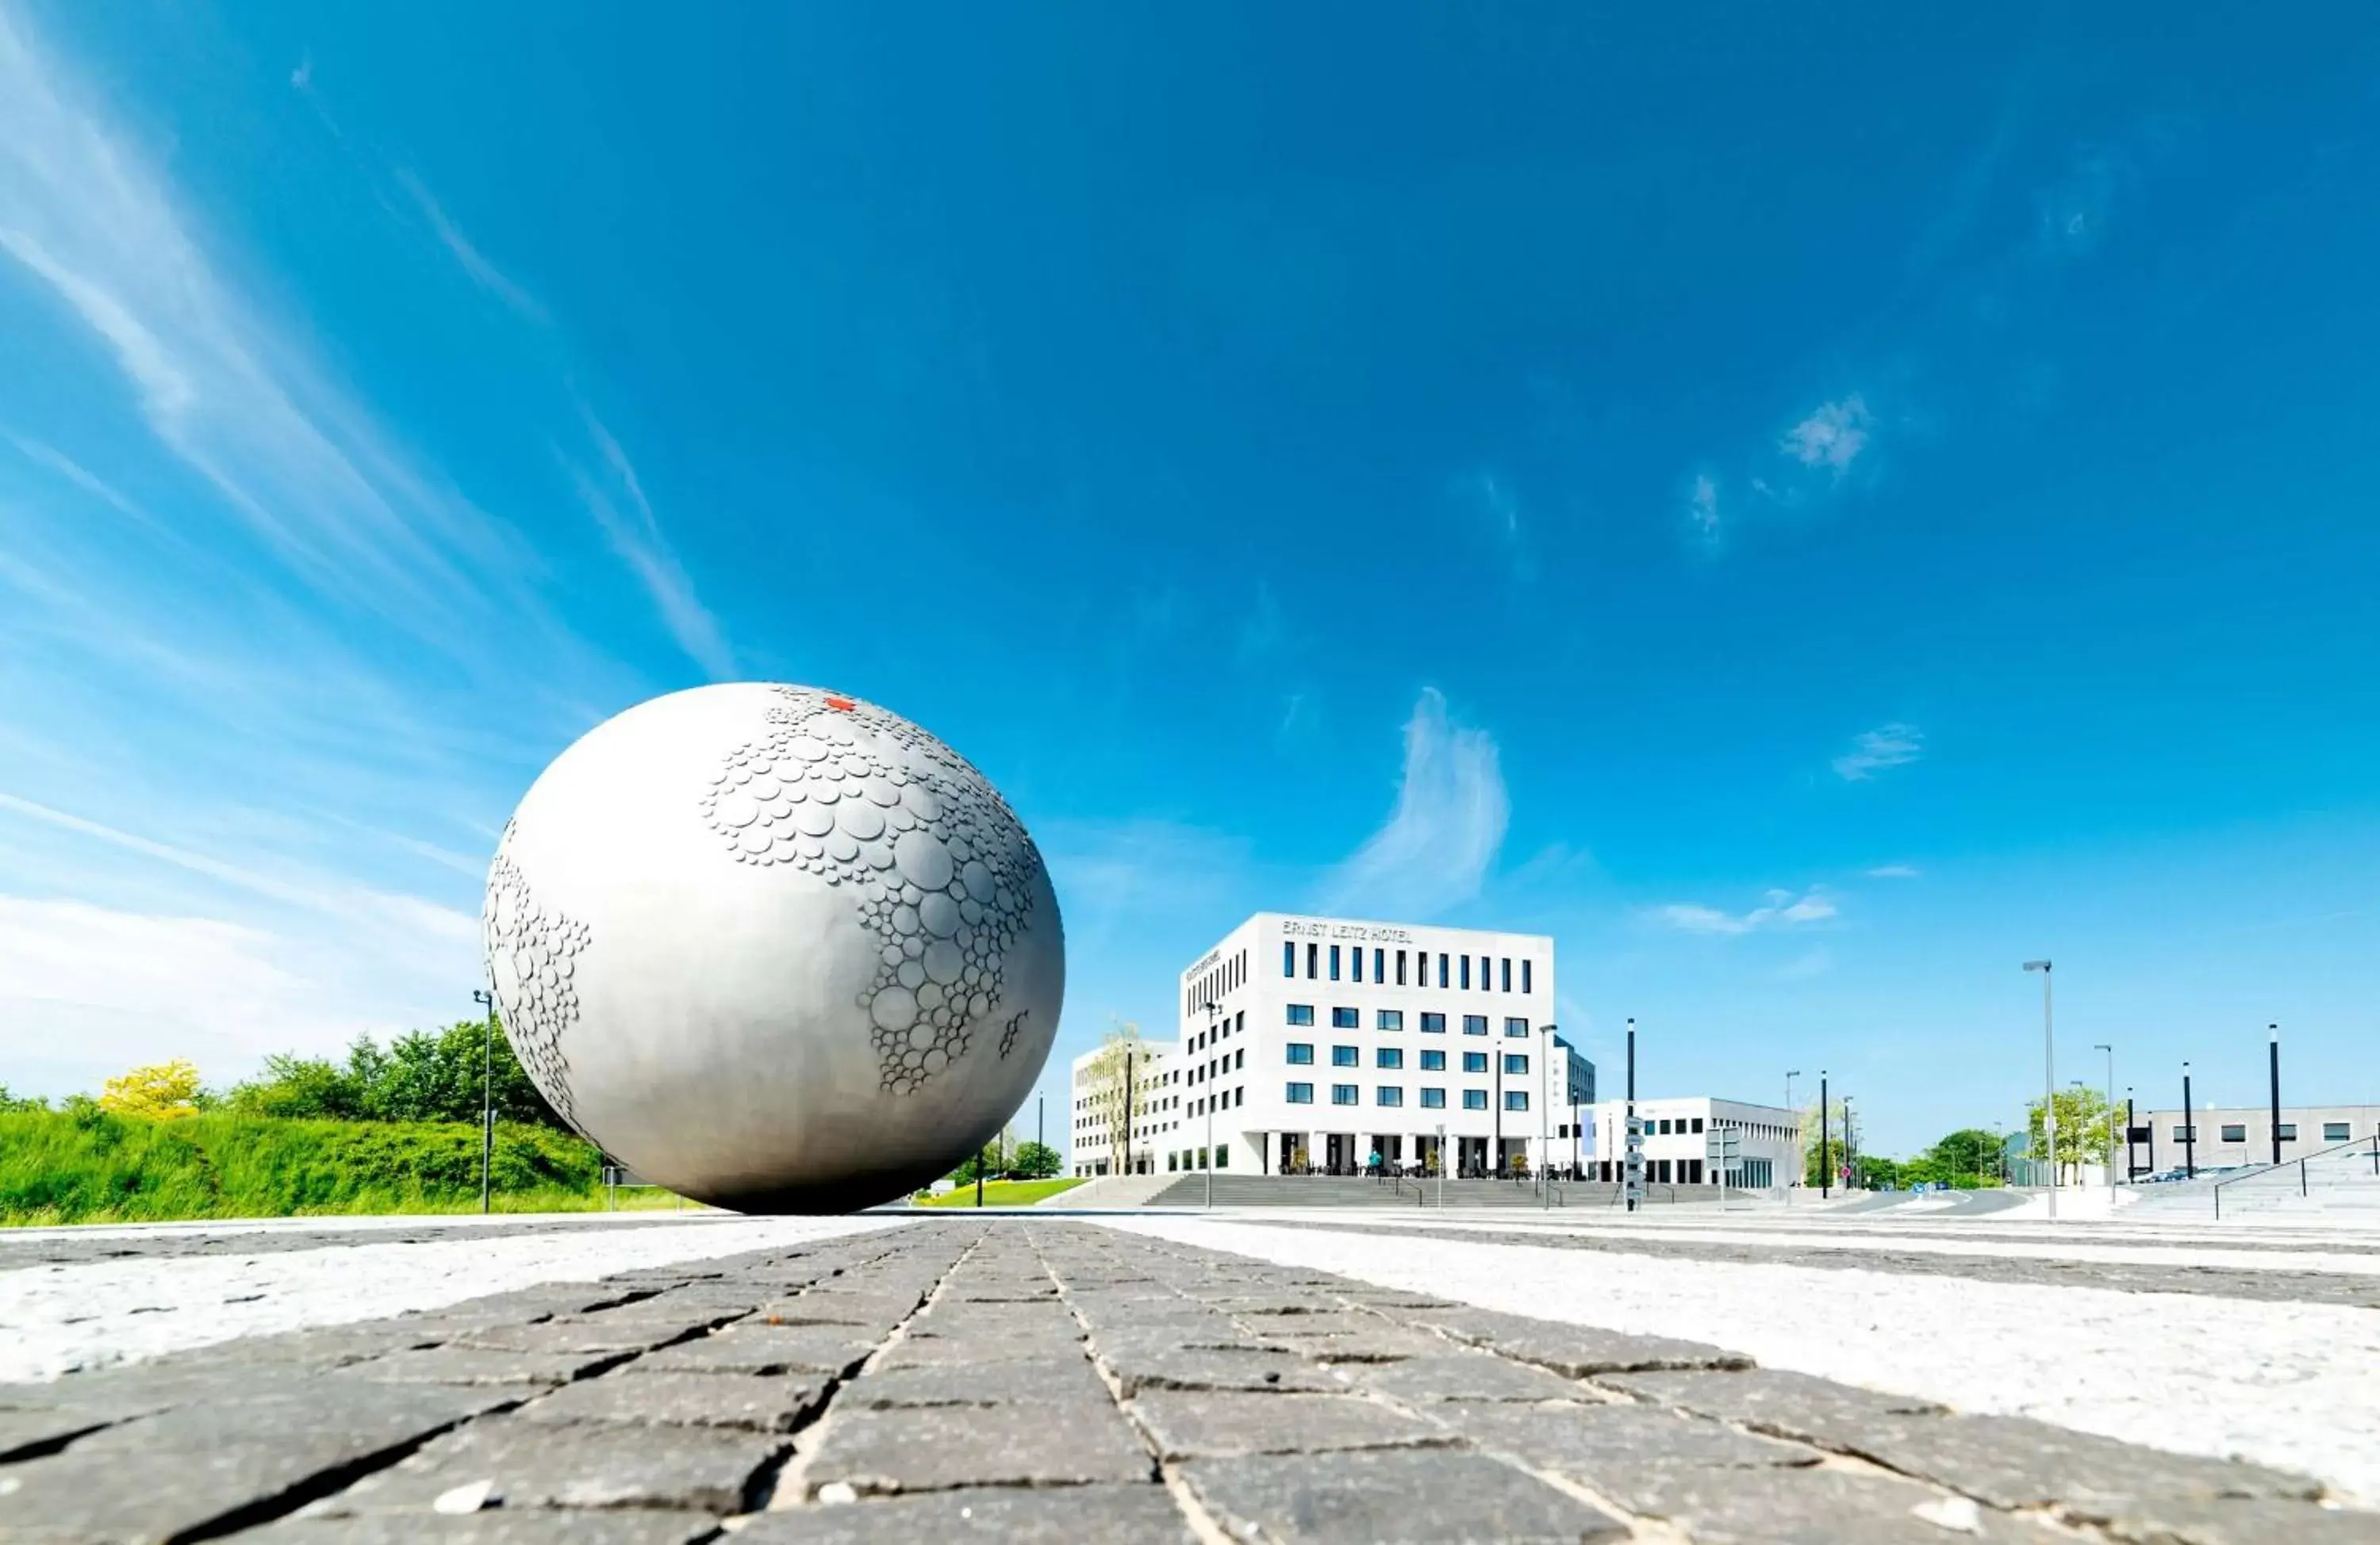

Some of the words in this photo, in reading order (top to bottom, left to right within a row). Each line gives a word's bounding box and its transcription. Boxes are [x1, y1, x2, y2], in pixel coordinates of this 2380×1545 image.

[1282, 921, 1328, 937] ERNST
[1331, 926, 1367, 940] LEITZ
[1370, 928, 1413, 944] HOTEL
